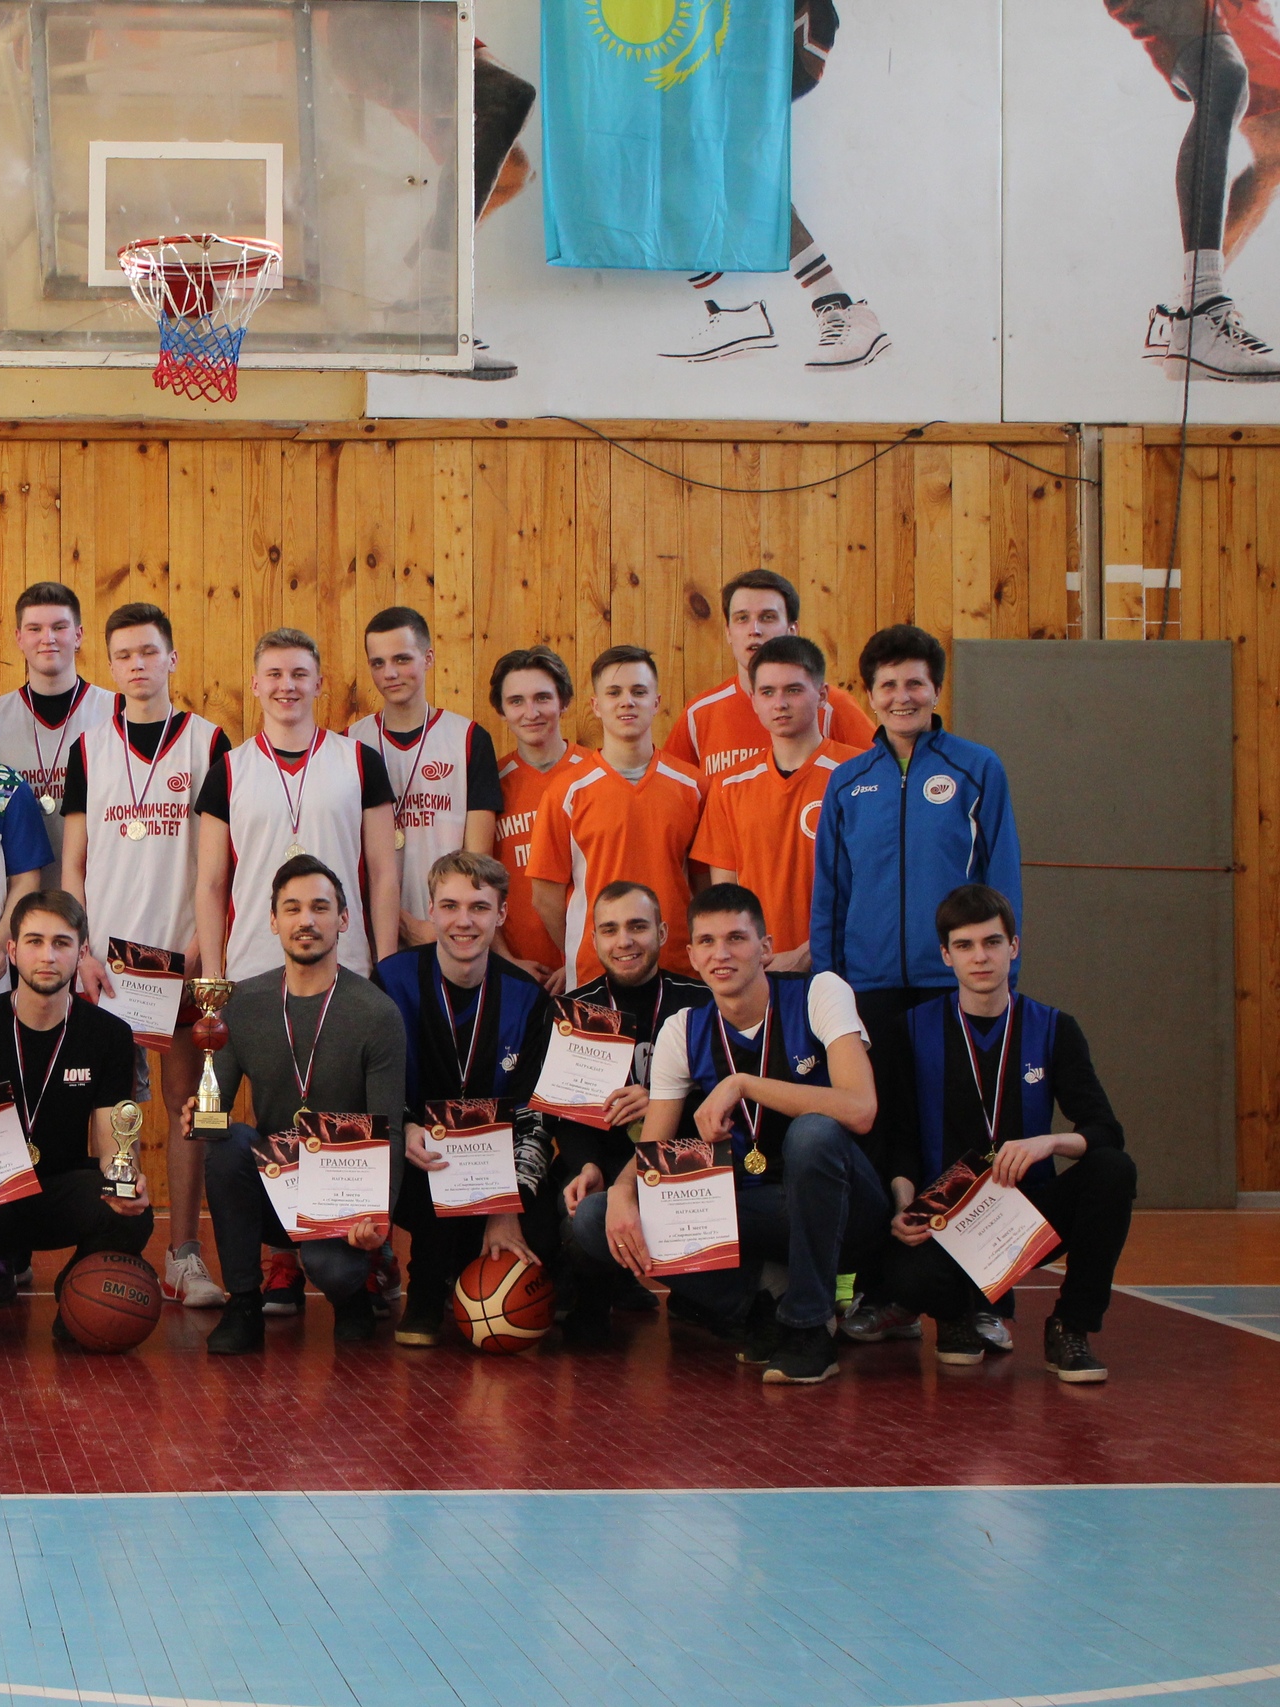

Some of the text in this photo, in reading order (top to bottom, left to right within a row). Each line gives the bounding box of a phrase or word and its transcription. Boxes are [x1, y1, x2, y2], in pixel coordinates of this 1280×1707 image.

[121, 980, 163, 994] ГРАМОТА
[568, 1042, 612, 1060] ГРАМОТА
[63, 1068, 91, 1081] LOVE
[446, 1143, 493, 1153] ГРАМОТА
[320, 1158, 368, 1167] ГРАМОТА
[661, 1188, 712, 1200] ГРАМОТА
[954, 1196, 997, 1233] ГРАМОТА
[103, 1281, 150, 1305] BM 900
